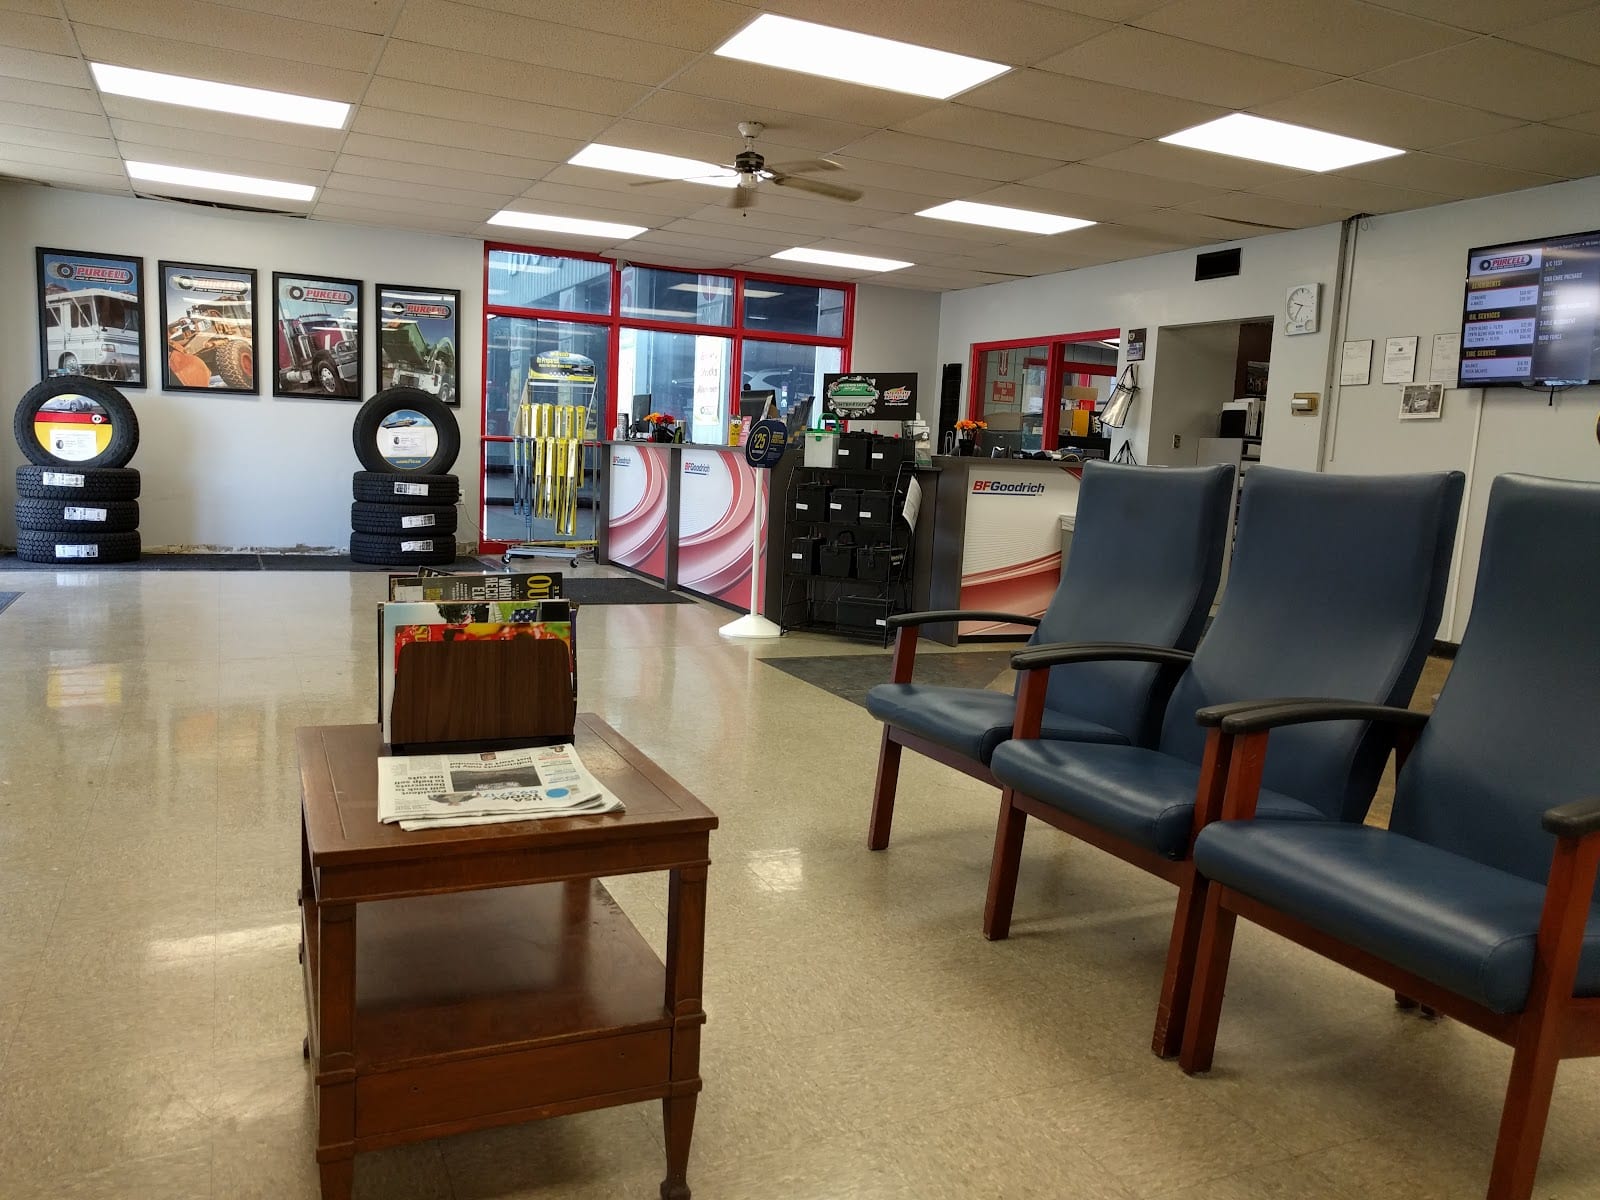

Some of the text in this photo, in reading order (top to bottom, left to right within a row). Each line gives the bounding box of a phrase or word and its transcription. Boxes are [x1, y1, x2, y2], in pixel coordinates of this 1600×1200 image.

[1492, 256, 1526, 267] PURCELL
[76, 267, 125, 279] PURCELL
[305, 289, 348, 301] PURCELL
[407, 304, 447, 315] PURCELL
[613, 456, 631, 465] BFGoodrich
[684, 462, 710, 473] BFGoodrich
[972, 480, 1046, 493] BFGoodrich
[485, 577, 499, 600] RECO
